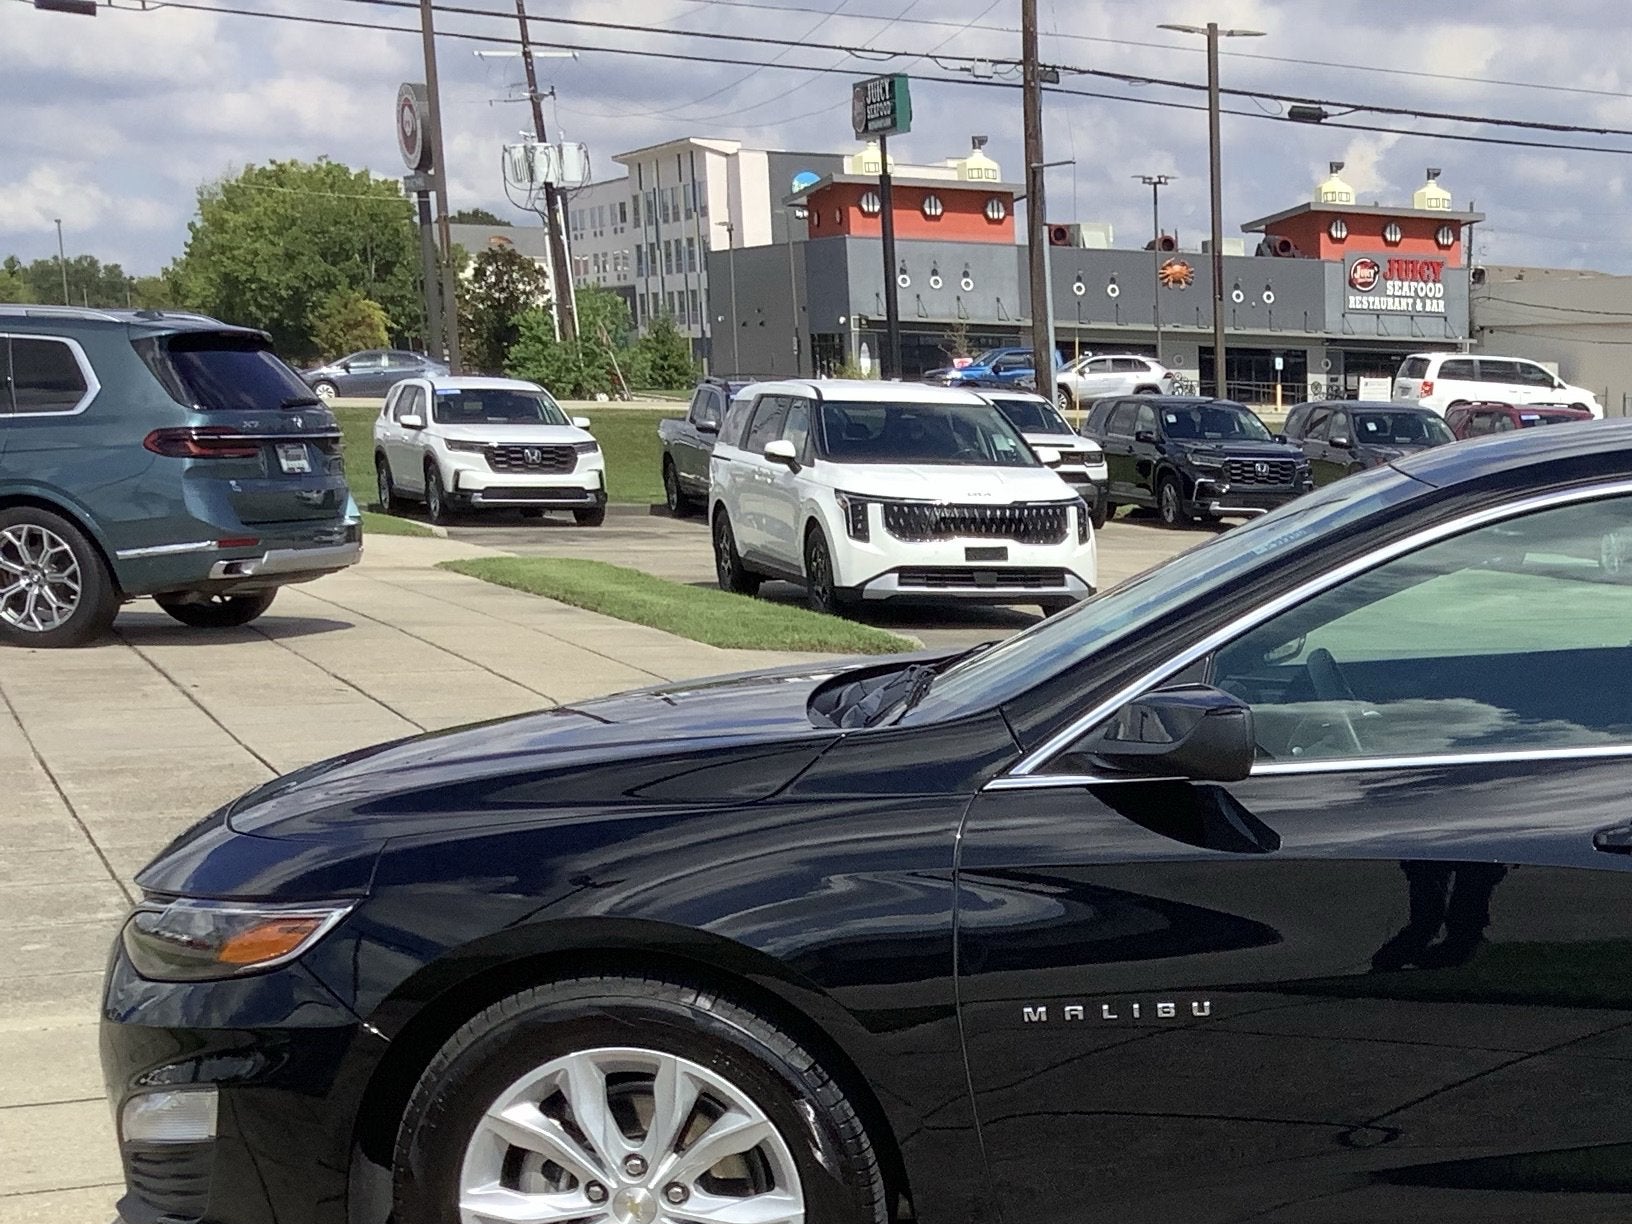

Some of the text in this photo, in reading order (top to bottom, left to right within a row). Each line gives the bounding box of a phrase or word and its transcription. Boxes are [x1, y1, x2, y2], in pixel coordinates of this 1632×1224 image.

[866, 78, 889, 104] JUICY
[867, 100, 890, 119] SEAFOOD
[1383, 258, 1444, 282] JUICY
[1386, 280, 1444, 298] SEAFOOD
[1348, 295, 1445, 312] RESTAURANT & BAR
[242, 420, 260, 428] X7
[1023, 1001, 1211, 1022] MALIBU
